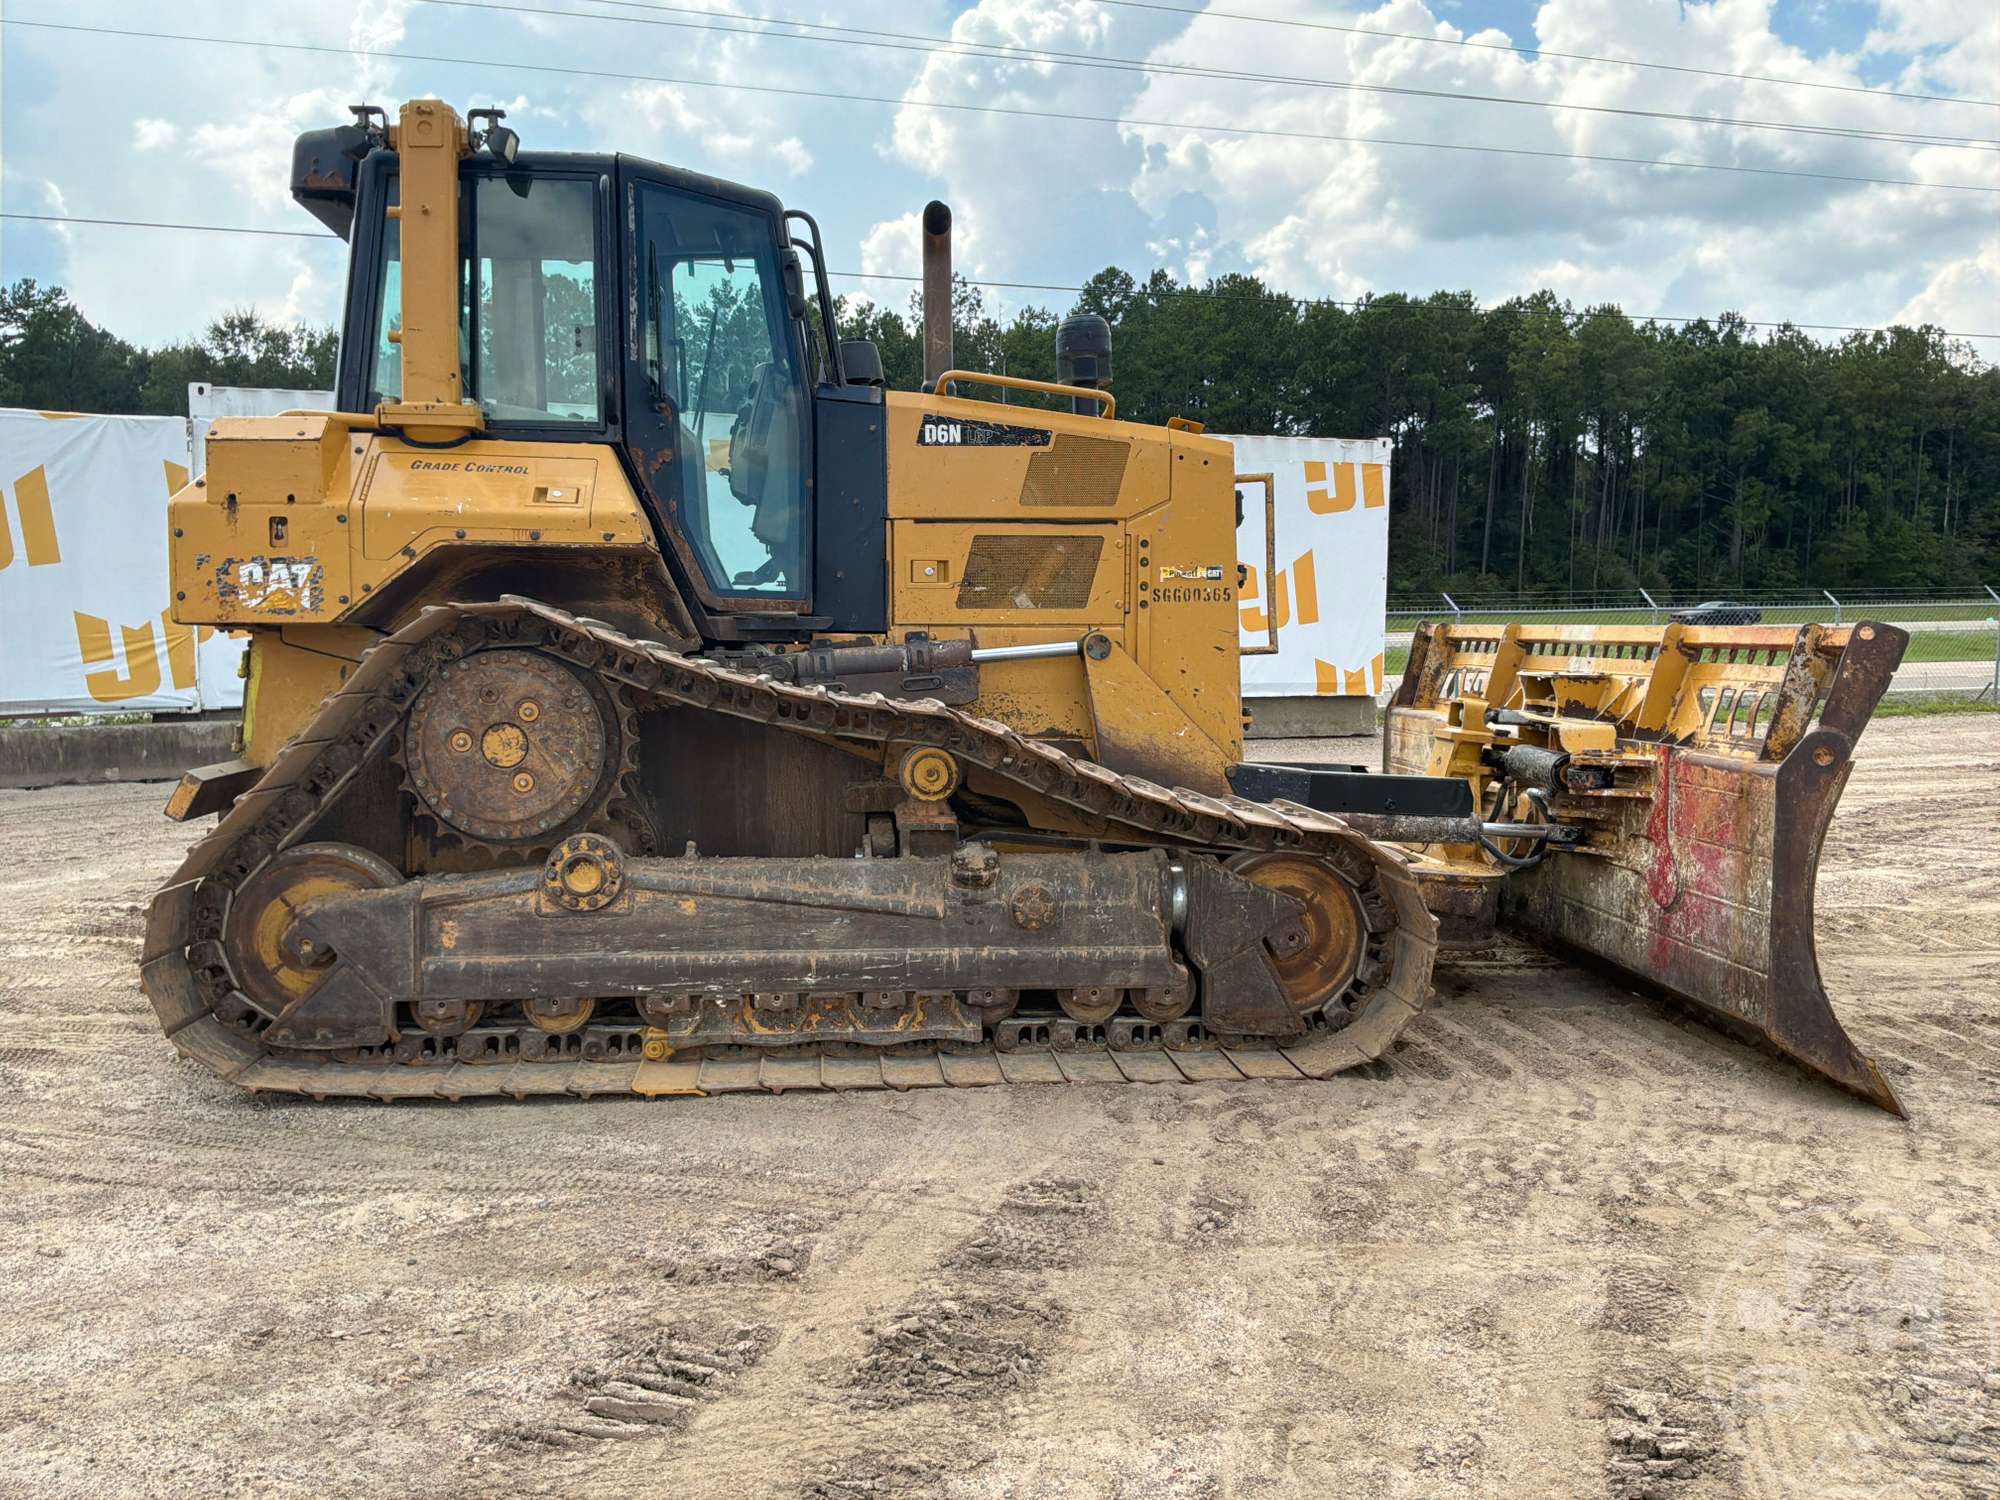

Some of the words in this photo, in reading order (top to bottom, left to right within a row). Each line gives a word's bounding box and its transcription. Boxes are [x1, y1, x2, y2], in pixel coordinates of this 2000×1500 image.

[924, 423, 961, 443] D6N
[410, 459, 461, 472] GRADE
[464, 461, 529, 475] CONTROL
[1152, 587, 1231, 603] SGG00365
